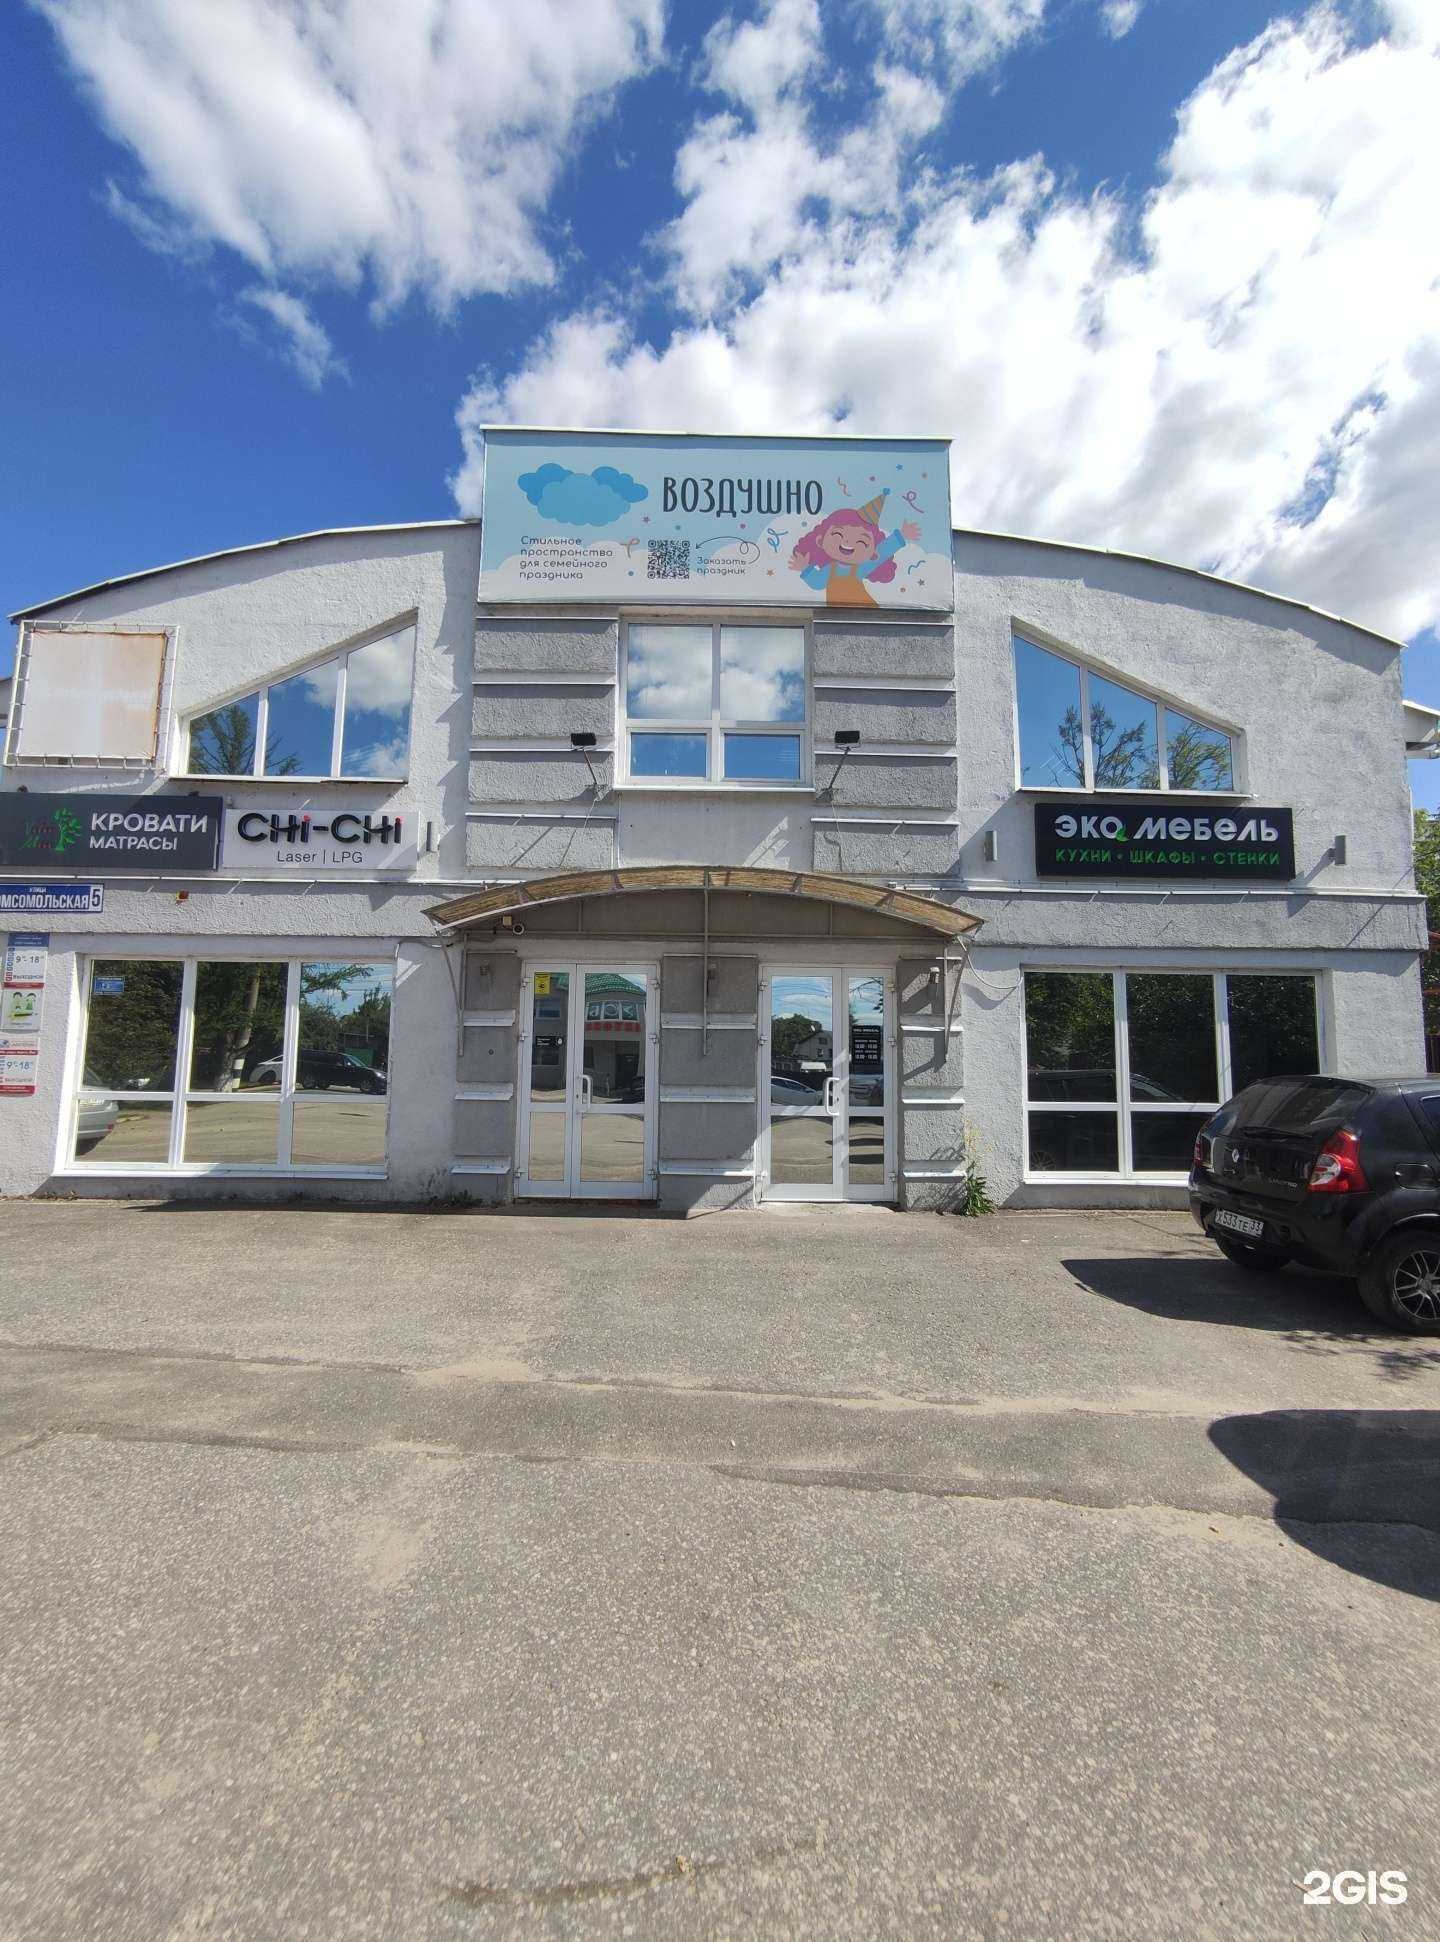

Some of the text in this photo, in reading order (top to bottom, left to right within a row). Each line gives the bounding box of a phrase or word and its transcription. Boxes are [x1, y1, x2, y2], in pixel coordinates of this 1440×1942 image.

[663, 477, 823, 518] ВОЗДУШНО
[520, 535, 582, 546] Стильное
[520, 548, 613, 558] пространство
[519, 558, 608, 569] для семейного
[696, 556, 747, 566] Заказать
[519, 571, 583, 581] праздника
[696, 567, 747, 577] праздник
[91, 812, 209, 834] КРОВАТИ
[1054, 814, 1124, 840] ЭКО
[89, 834, 179, 851] МАТРАСЫ
[277, 850, 316, 864] Laser
[331, 850, 364, 864] LPG
[1055, 849, 1280, 866] КУХНИ ШКАФЫ СТЕНКИ
[0, 888, 101, 909] МСОМОЛЬСКАЯ 5
